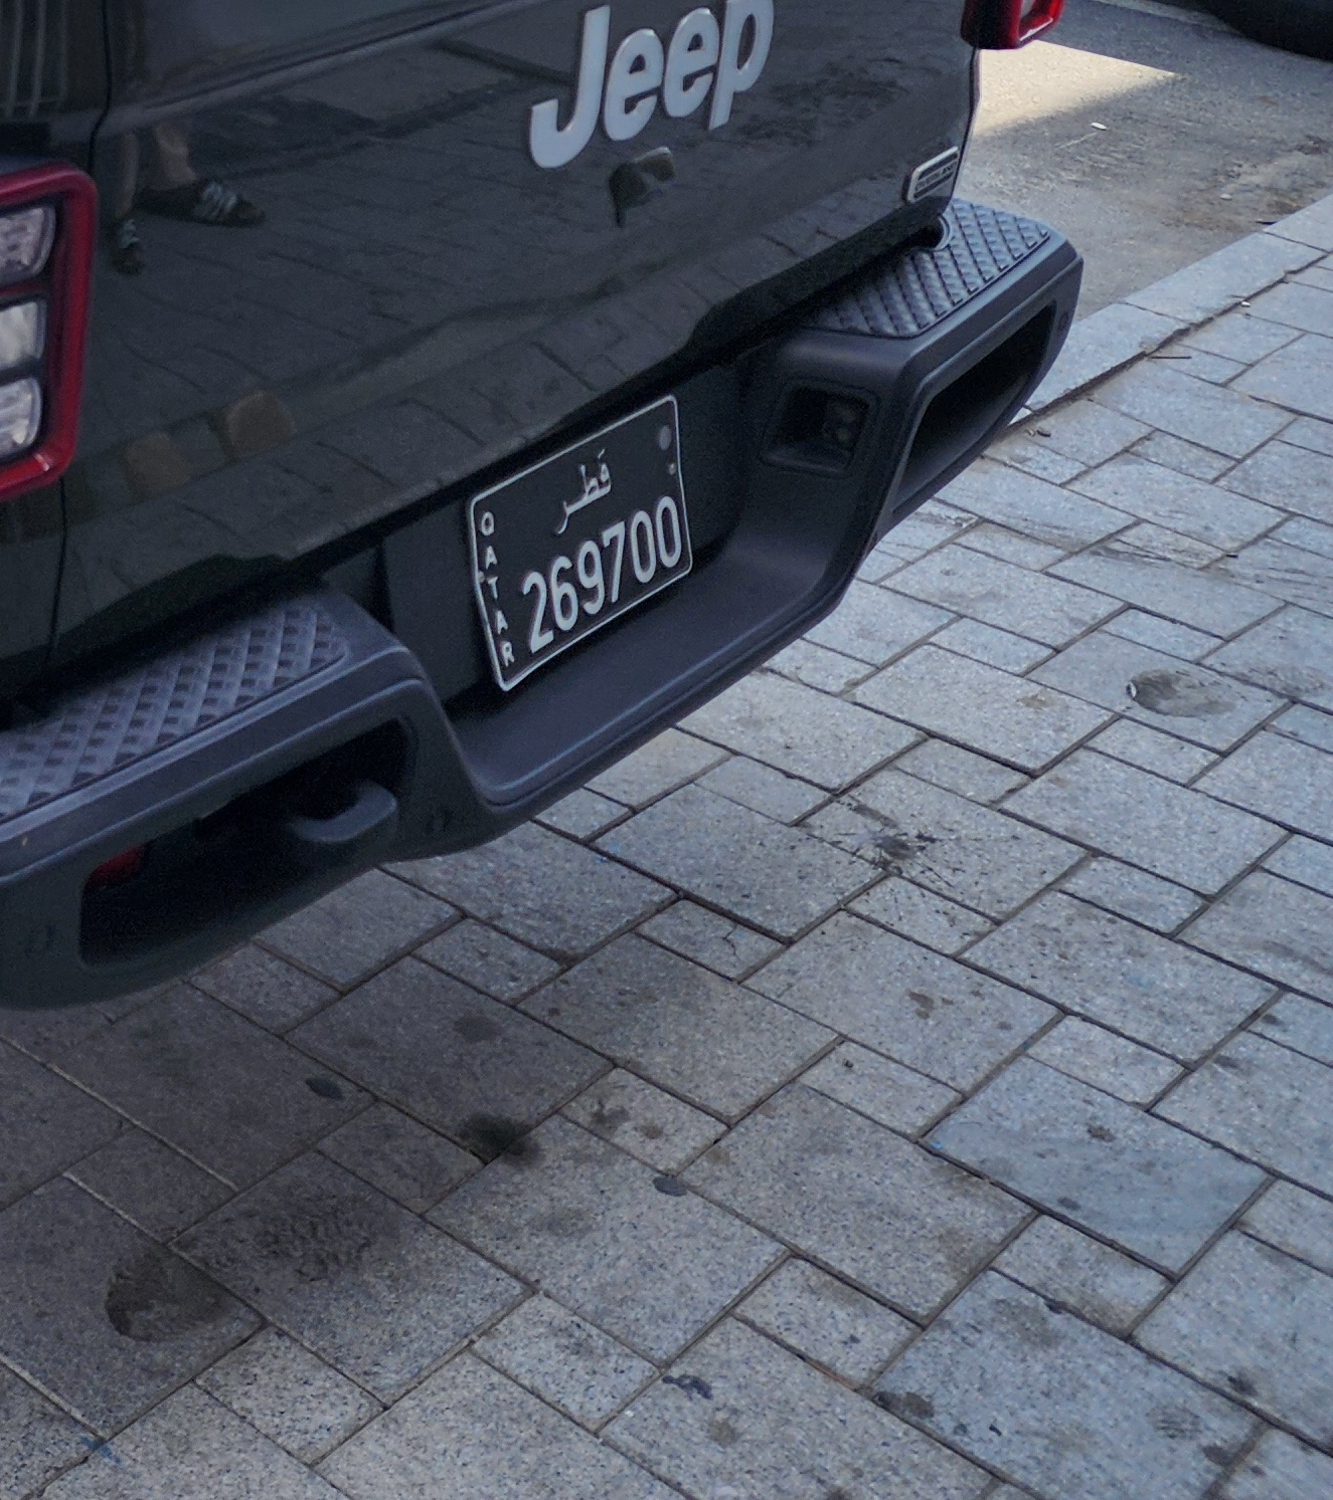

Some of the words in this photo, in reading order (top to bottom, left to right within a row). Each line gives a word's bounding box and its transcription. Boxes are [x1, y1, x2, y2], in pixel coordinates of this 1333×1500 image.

[554, 448, 612, 536] قطر
[480, 511, 515, 667] QATAR
[521, 495, 683, 654] 269700
